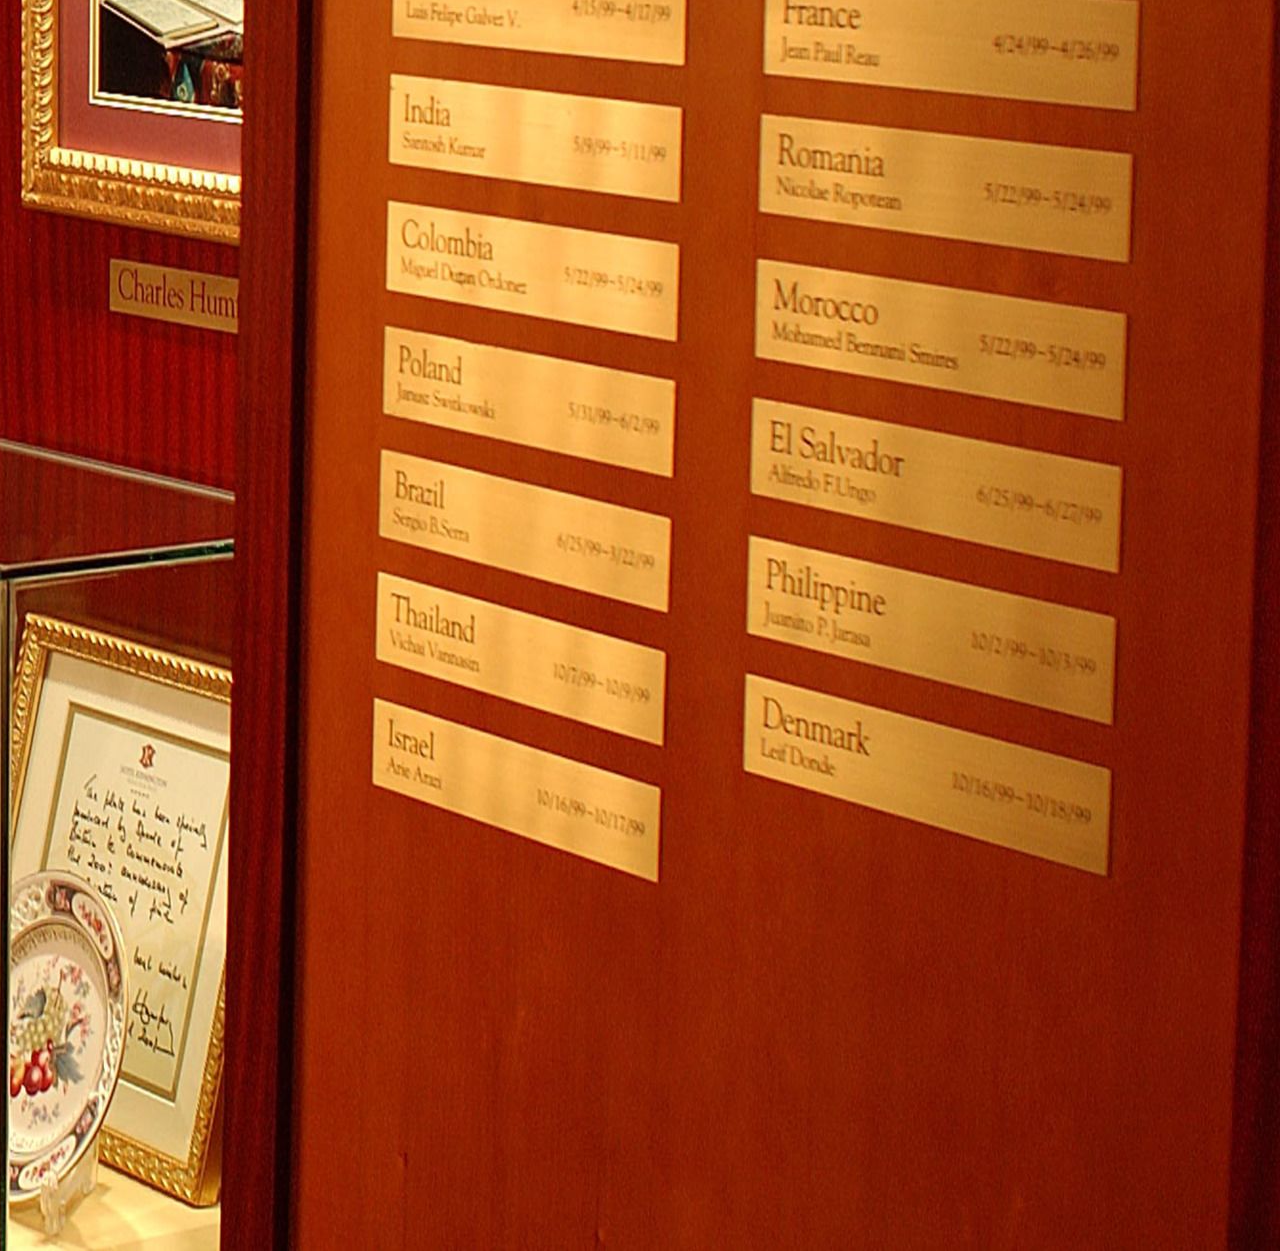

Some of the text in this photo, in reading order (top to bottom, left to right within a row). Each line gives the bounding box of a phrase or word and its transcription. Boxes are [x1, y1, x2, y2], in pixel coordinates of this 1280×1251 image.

[779, 35, 810, 63] Jean
[812, 40, 842, 65] Paul
[402, 92, 452, 129] India
[776, 132, 886, 179] Romania
[400, 217, 495, 263] Colombia
[117, 267, 236, 320] Charles Hum
[772, 276, 881, 328] Morocco
[397, 343, 463, 387] Poland
[769, 419, 907, 480] El Salvador
[394, 469, 446, 511] Brazil
[764, 557, 888, 618] Philippine
[389, 591, 477, 646] Thailand
[387, 717, 436, 762] Israel
[761, 696, 872, 758] Denmark
